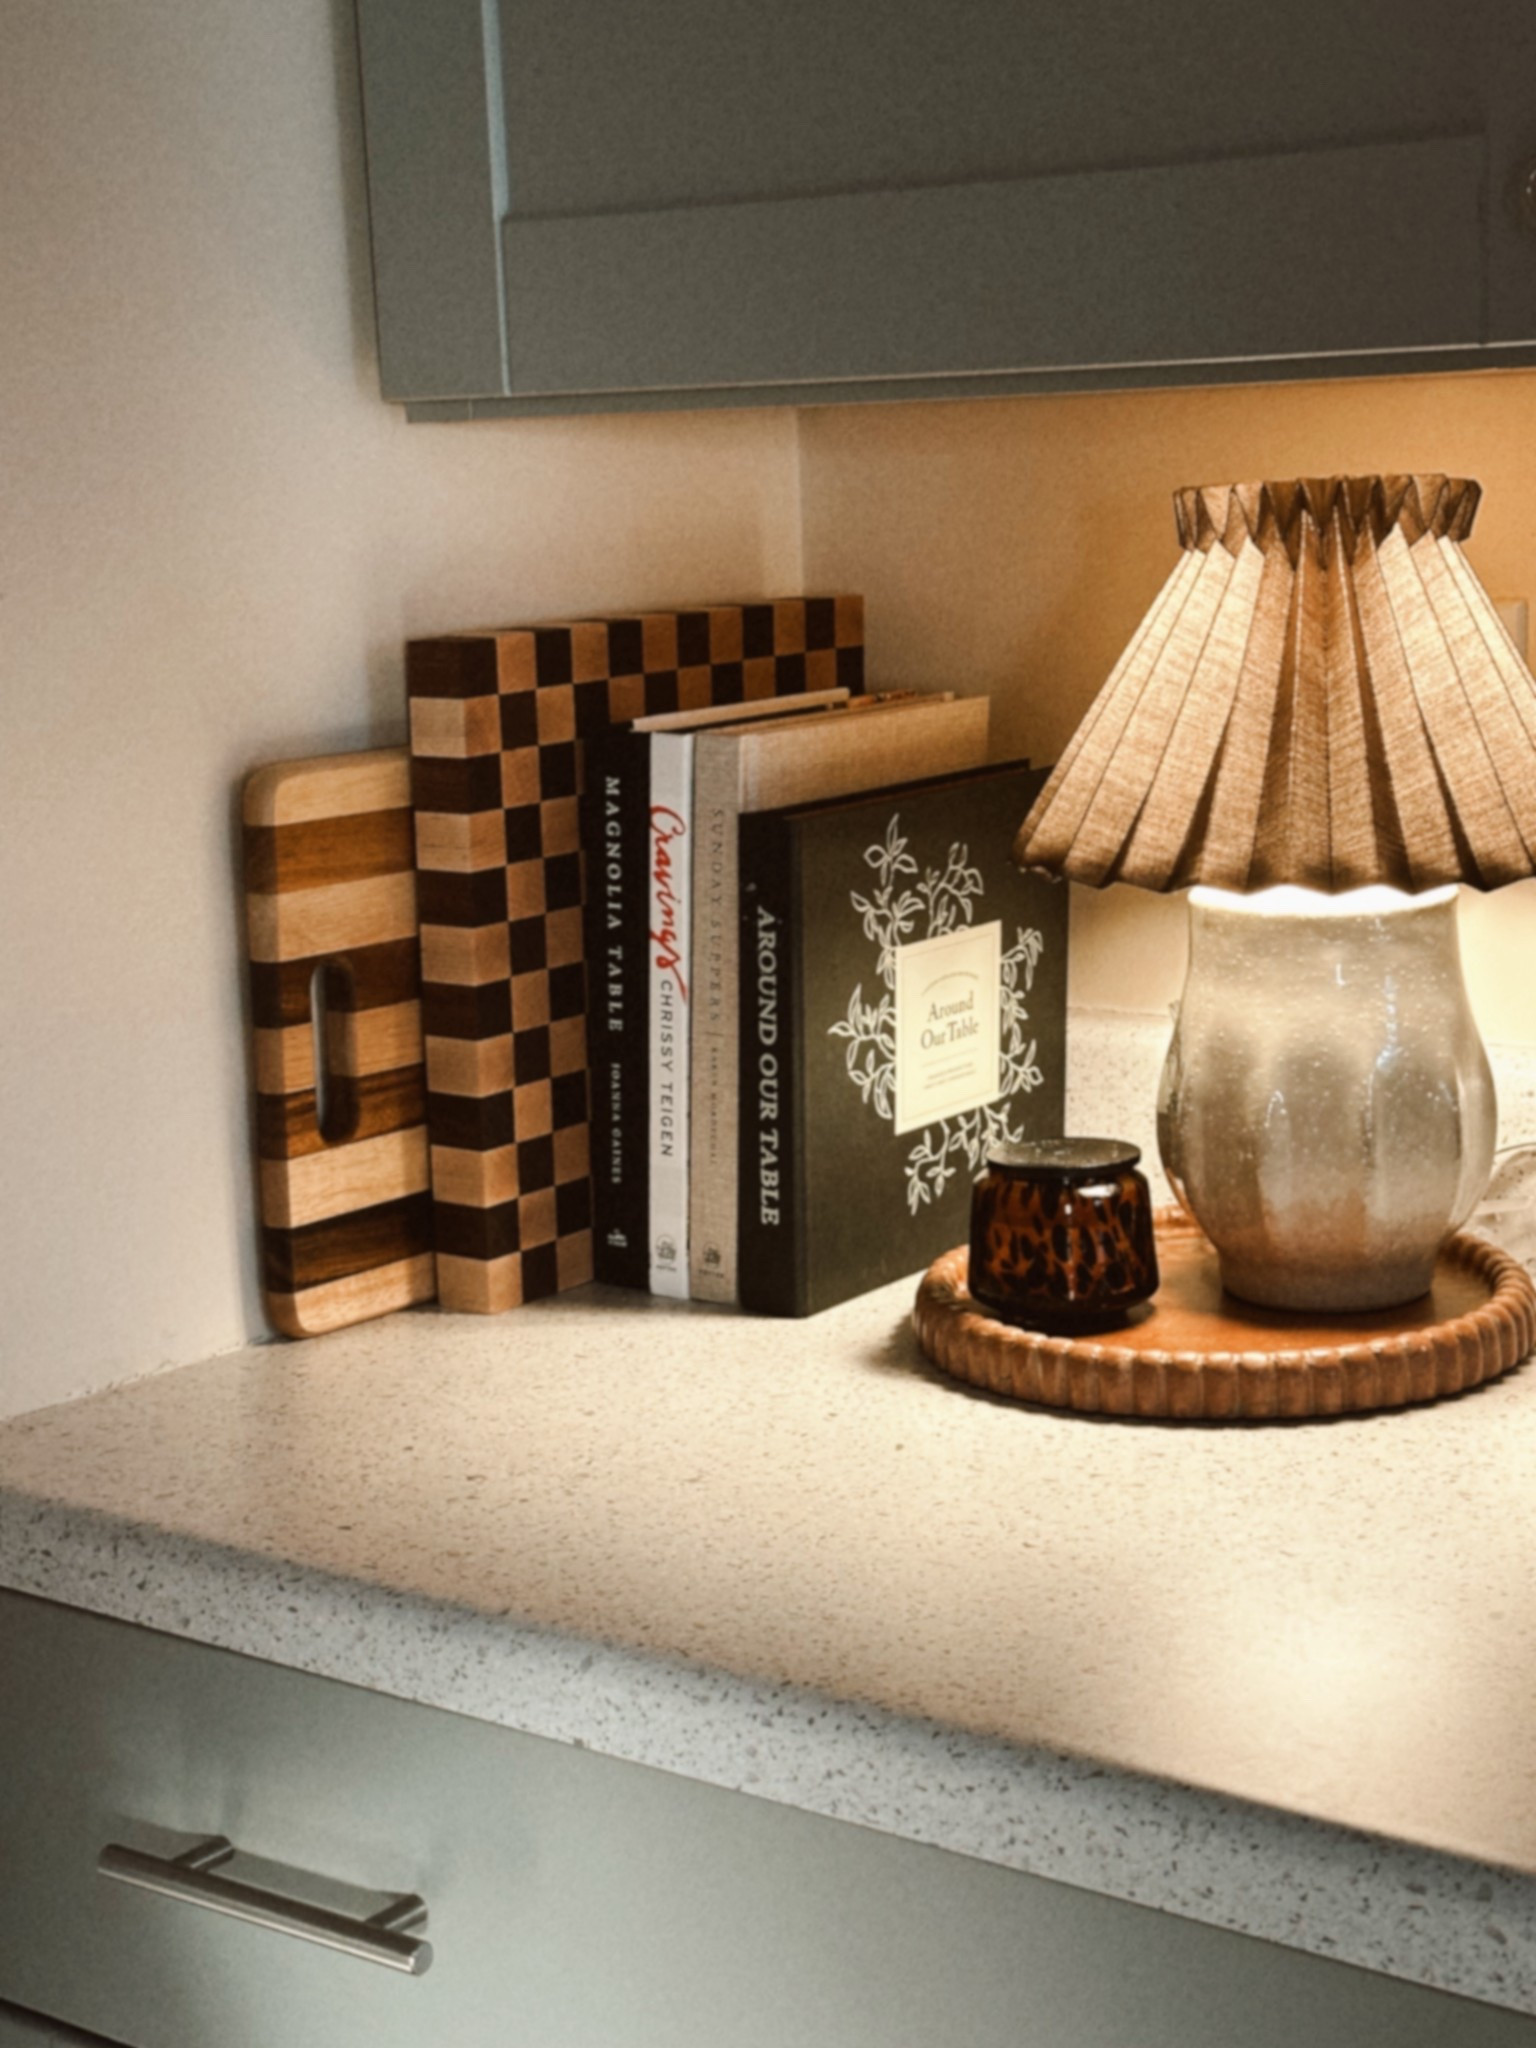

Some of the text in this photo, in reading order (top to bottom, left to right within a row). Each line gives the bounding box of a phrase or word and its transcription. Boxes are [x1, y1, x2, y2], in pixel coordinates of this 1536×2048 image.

[605, 776, 623, 1031] MAGNOLIA TABLE
[649, 805, 687, 1004] Cravings
[709, 808, 724, 1021] SUNDAY SUPPERS
[610, 1063, 621, 1122] JOANNA
[660, 979, 674, 1157] CHRISSY TEIGEN
[757, 905, 779, 1225] AROUND OUR TABLE
[920, 1016, 979, 1050] Our Table
[927, 990, 974, 1023] Around
